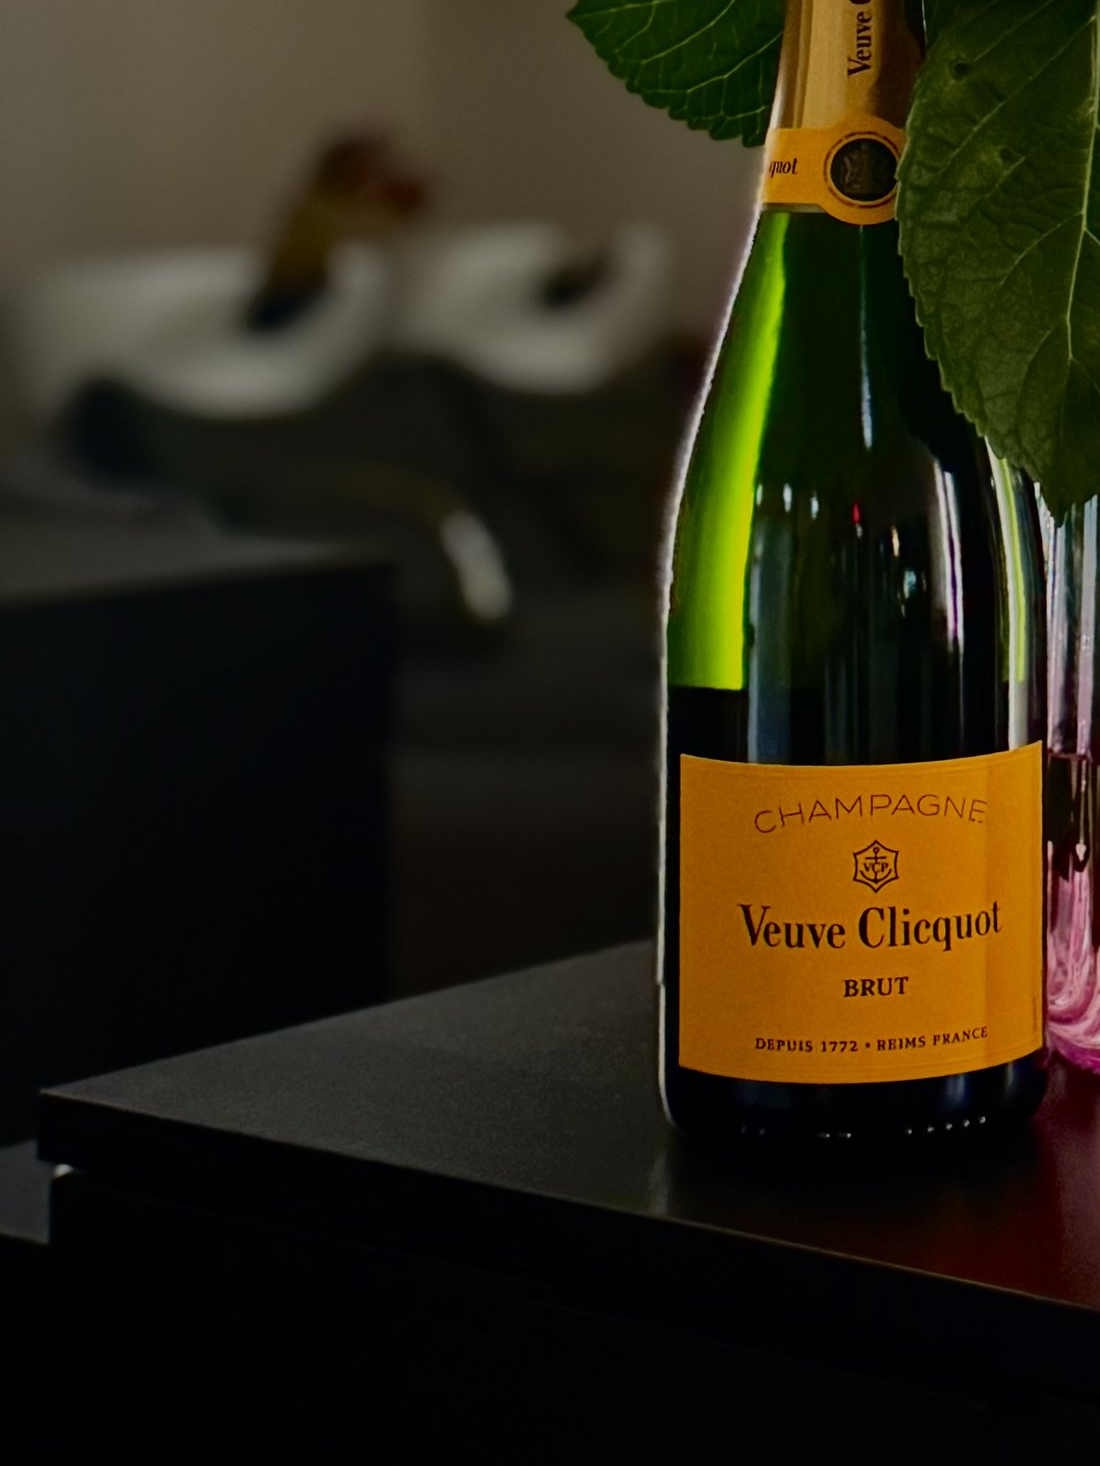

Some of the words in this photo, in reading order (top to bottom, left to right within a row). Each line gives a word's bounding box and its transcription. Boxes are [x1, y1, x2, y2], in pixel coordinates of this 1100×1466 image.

[847, 10, 873, 77] Veuve
[753, 793, 988, 834] CHAMPAGNE
[862, 861, 890, 873] VCP
[737, 903, 846, 950] Veuve
[858, 900, 1002, 952] Clicquot
[843, 975, 910, 998] BRUT
[754, 1037, 814, 1053] DEPUIS
[820, 1040, 859, 1053] 1772
[876, 1035, 927, 1052] REIMS
[932, 1025, 989, 1048] FRANCE
